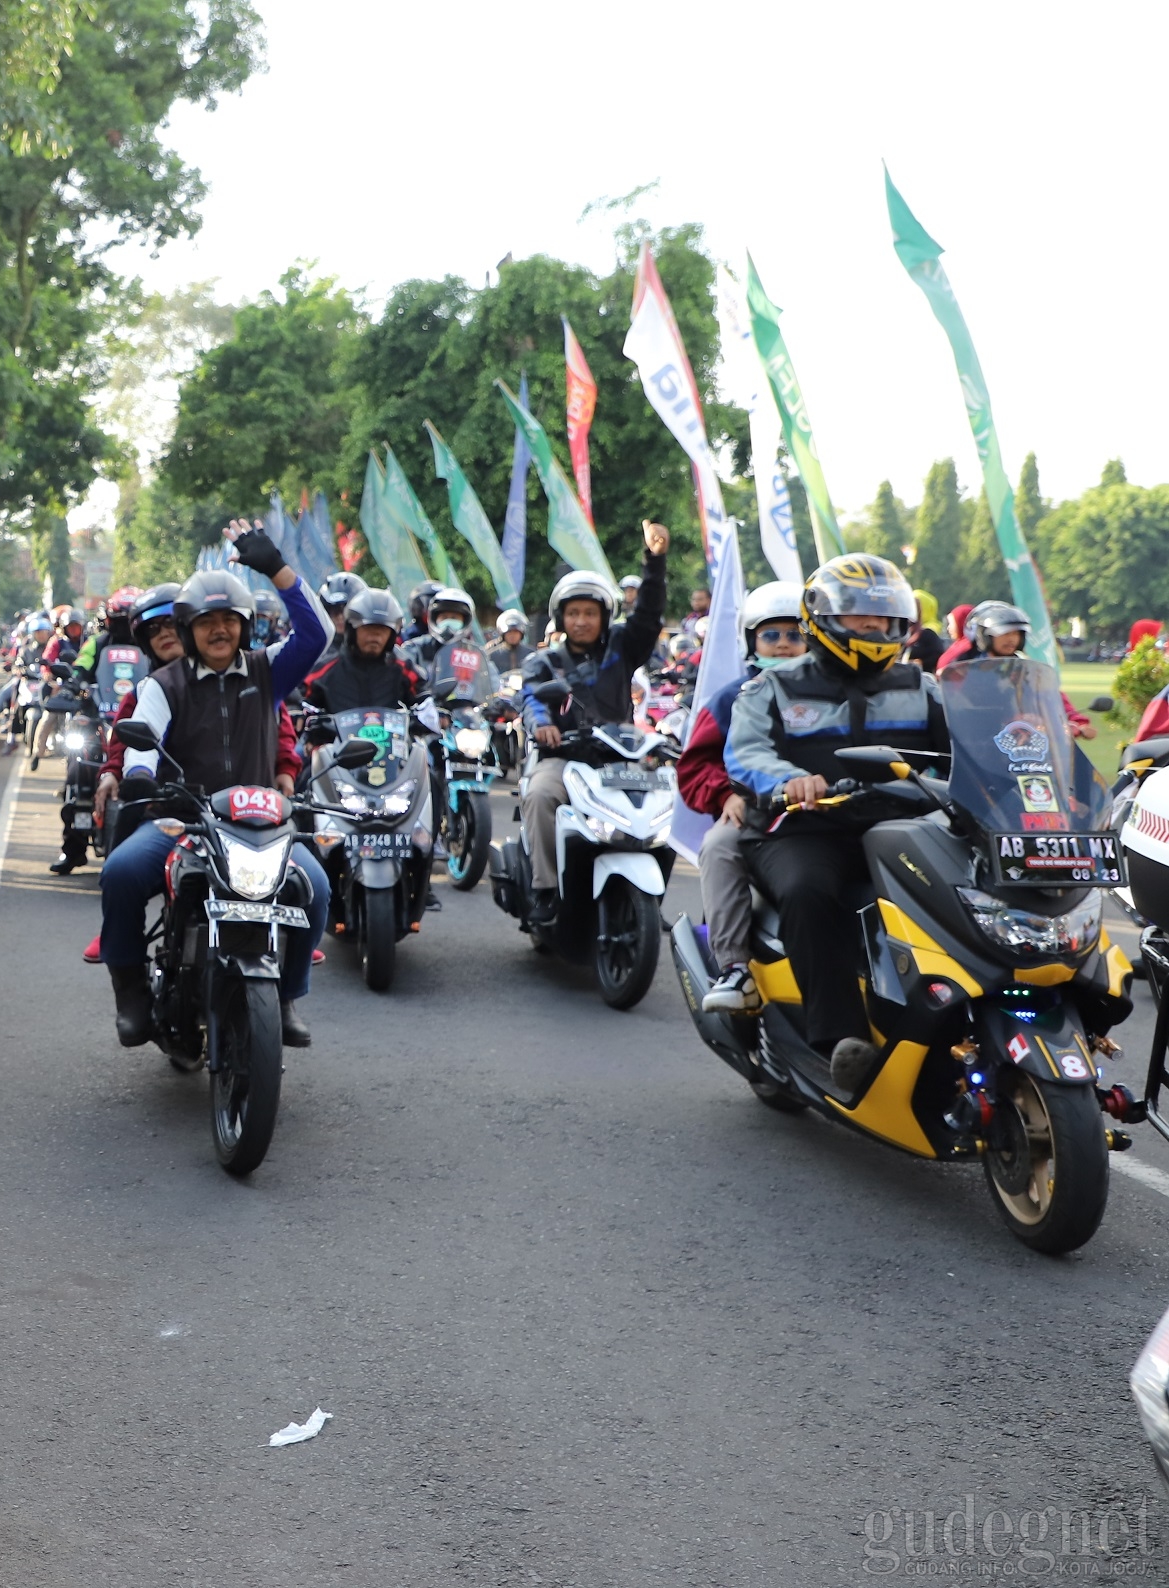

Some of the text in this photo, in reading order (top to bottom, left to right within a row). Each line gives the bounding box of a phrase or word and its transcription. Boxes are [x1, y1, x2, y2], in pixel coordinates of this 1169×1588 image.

[233, 789, 279, 814] 041
[344, 833, 411, 847] AB 2348 KY
[1000, 837, 1115, 859] AB 5311 MX
[209, 903, 228, 912] AB
[1007, 1036, 1031, 1065] 1
[1060, 1055, 1087, 1078] 8
